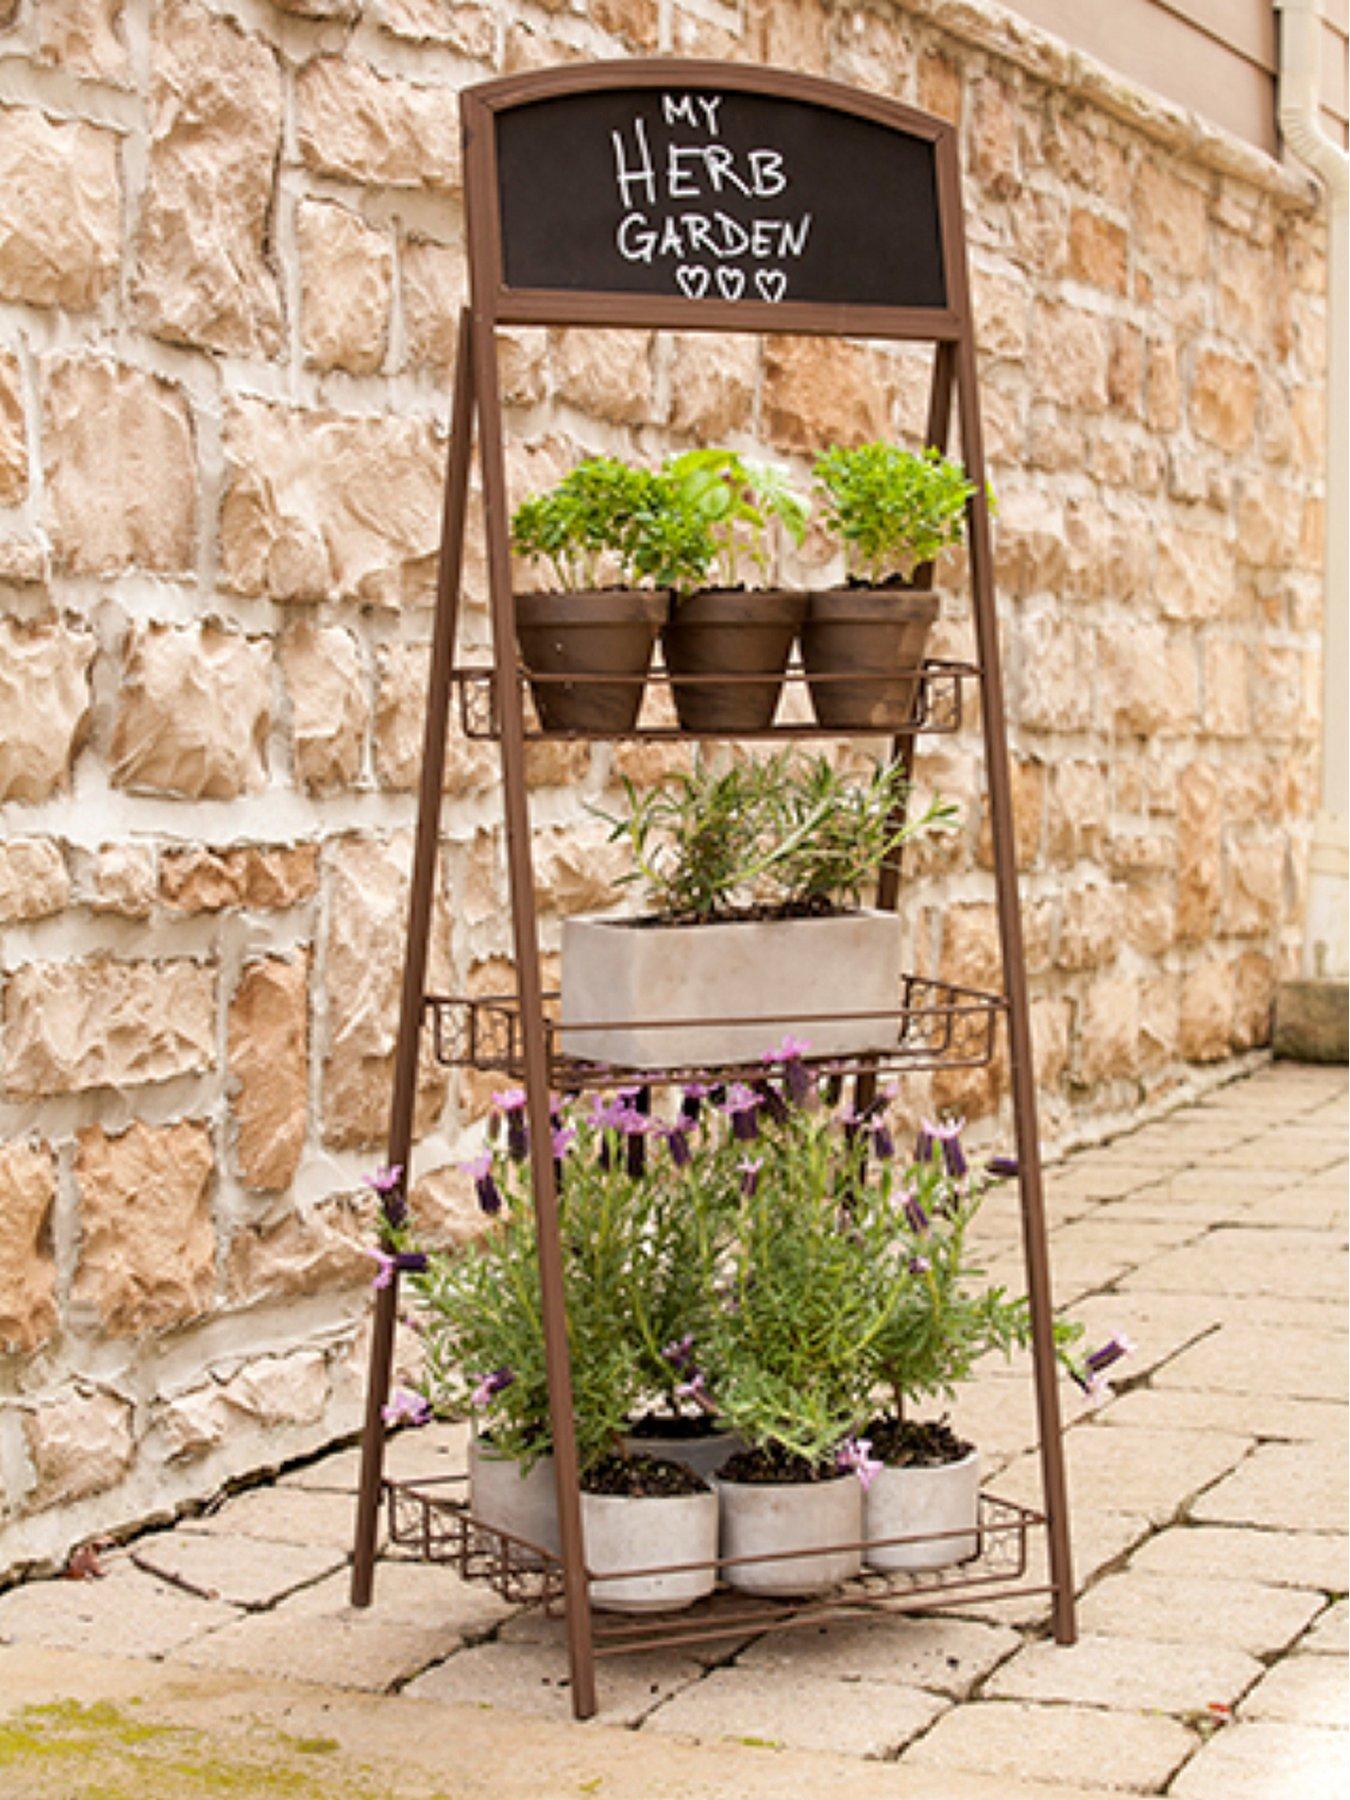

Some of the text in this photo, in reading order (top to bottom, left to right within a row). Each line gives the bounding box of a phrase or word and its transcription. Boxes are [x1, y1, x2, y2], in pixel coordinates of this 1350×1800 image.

[662, 94, 721, 136] MY
[612, 118, 787, 208] HERB
[616, 211, 811, 263] GARDEN
